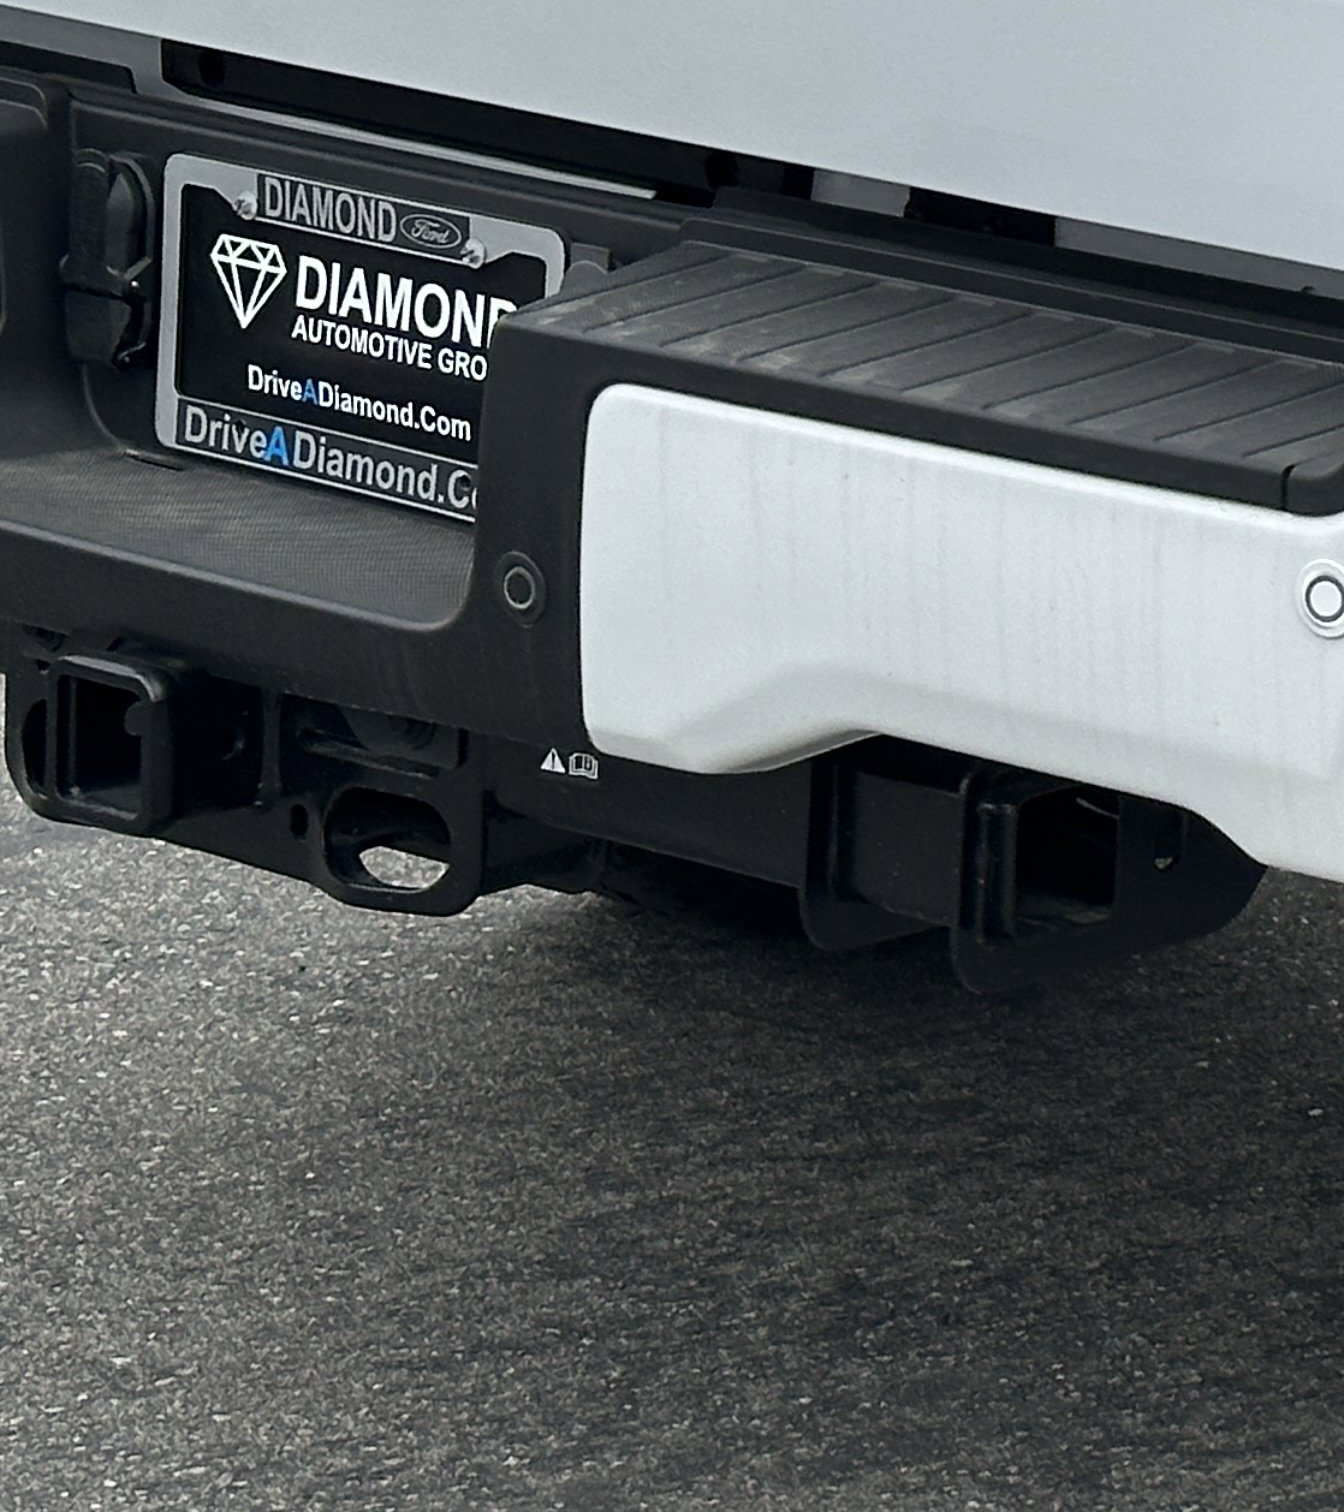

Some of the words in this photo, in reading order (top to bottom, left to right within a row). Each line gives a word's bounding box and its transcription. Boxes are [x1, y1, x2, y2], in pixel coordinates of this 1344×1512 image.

[263, 176, 397, 244] DIAMOND
[408, 216, 451, 246] Ford
[291, 314, 432, 370] AUTOMOTIVE
[437, 346, 488, 382] GRO
[247, 364, 472, 442] DriveADiamond.Com
[184, 404, 479, 511] DriveADiamond.C
